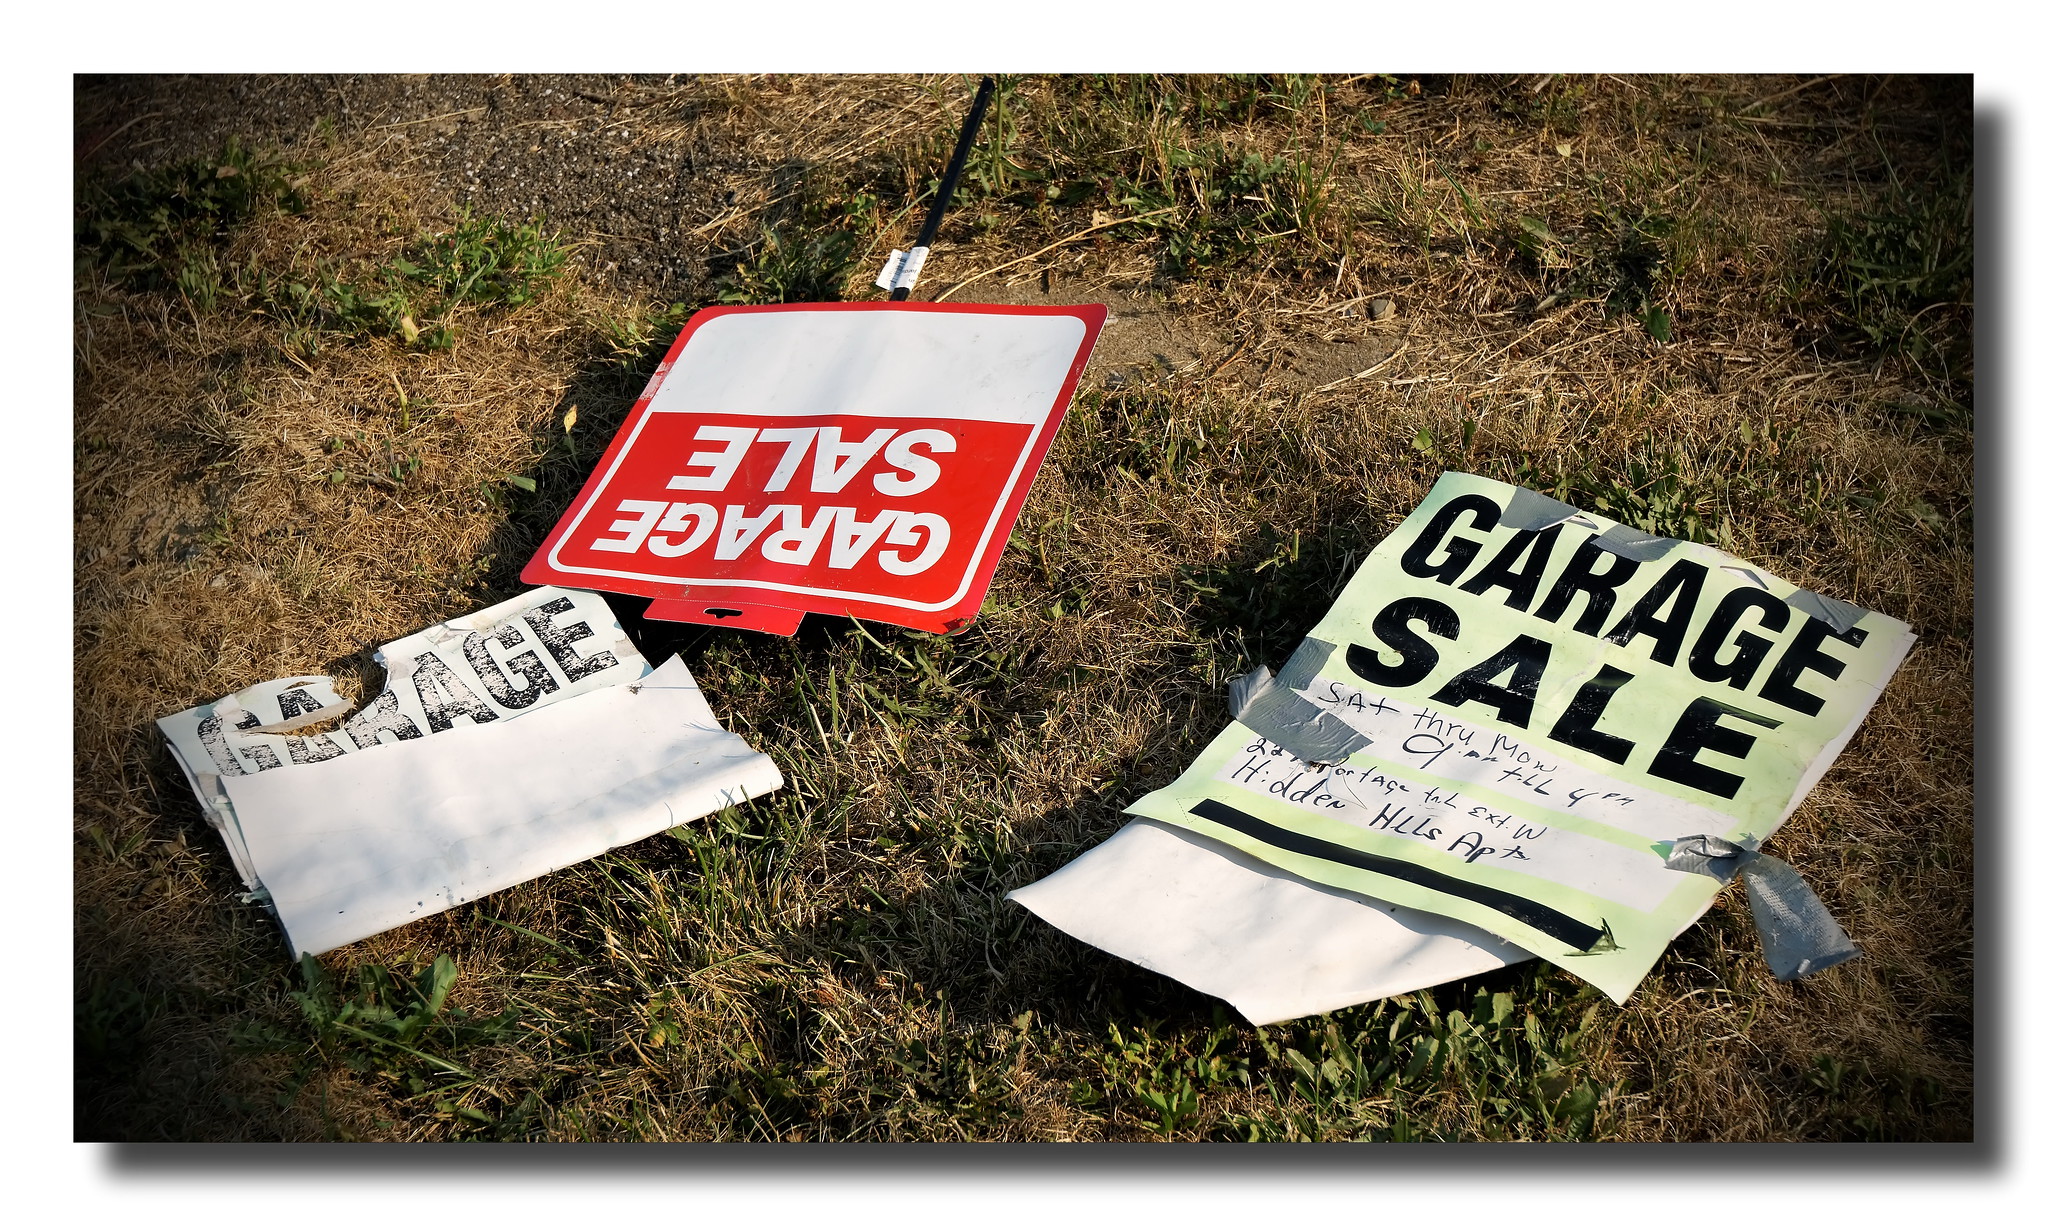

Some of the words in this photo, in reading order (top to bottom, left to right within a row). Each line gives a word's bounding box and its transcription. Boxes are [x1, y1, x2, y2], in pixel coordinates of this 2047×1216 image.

[666, 425, 957, 497] SALE
[590, 500, 951, 576] GARAGE
[1400, 493, 1868, 718] GARAGE
[1346, 596, 1783, 800] SALE
[1230, 754, 1346, 809] Hidden
